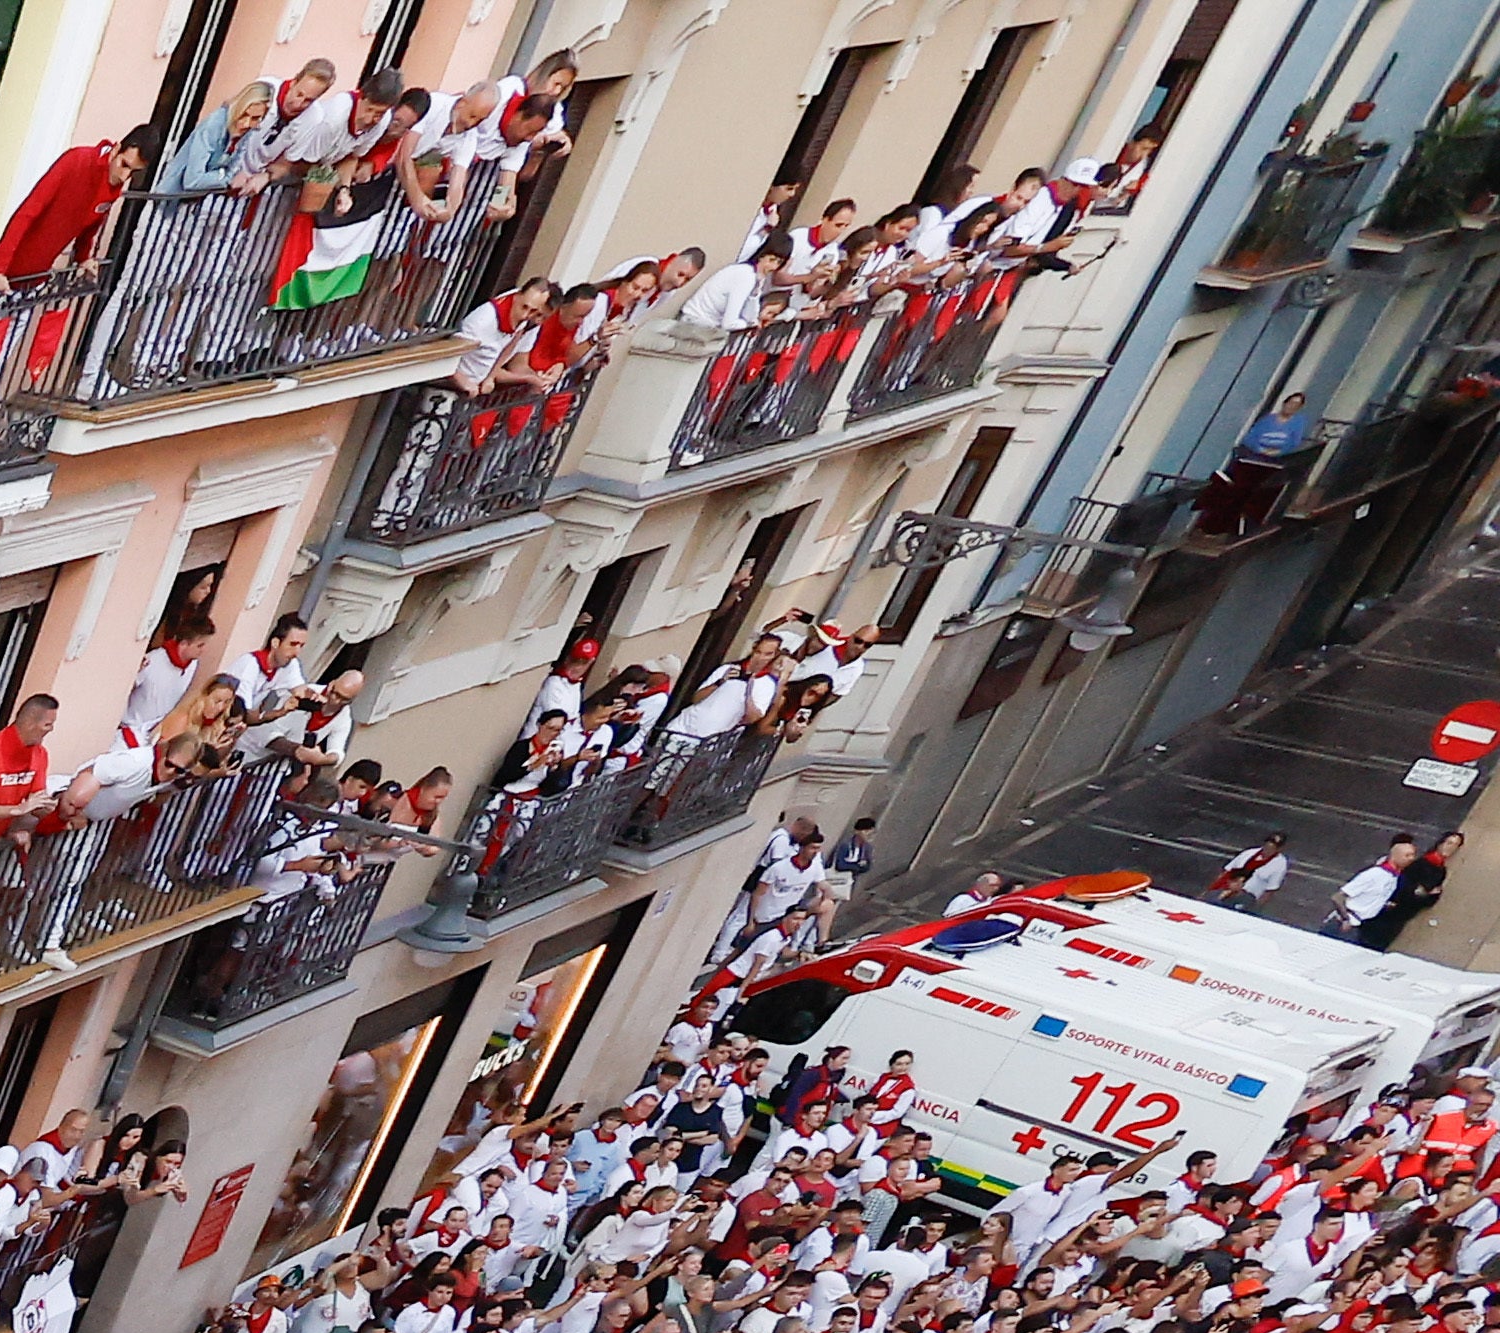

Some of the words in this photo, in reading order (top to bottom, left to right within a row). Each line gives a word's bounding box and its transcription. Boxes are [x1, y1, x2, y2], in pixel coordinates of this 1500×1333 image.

[1065, 1027, 1132, 1056] SOPORTE
[1132, 1047, 1172, 1070] VITAL
[1174, 1059, 1230, 1086] BÁSICO
[1060, 1071, 1181, 1150] 112
